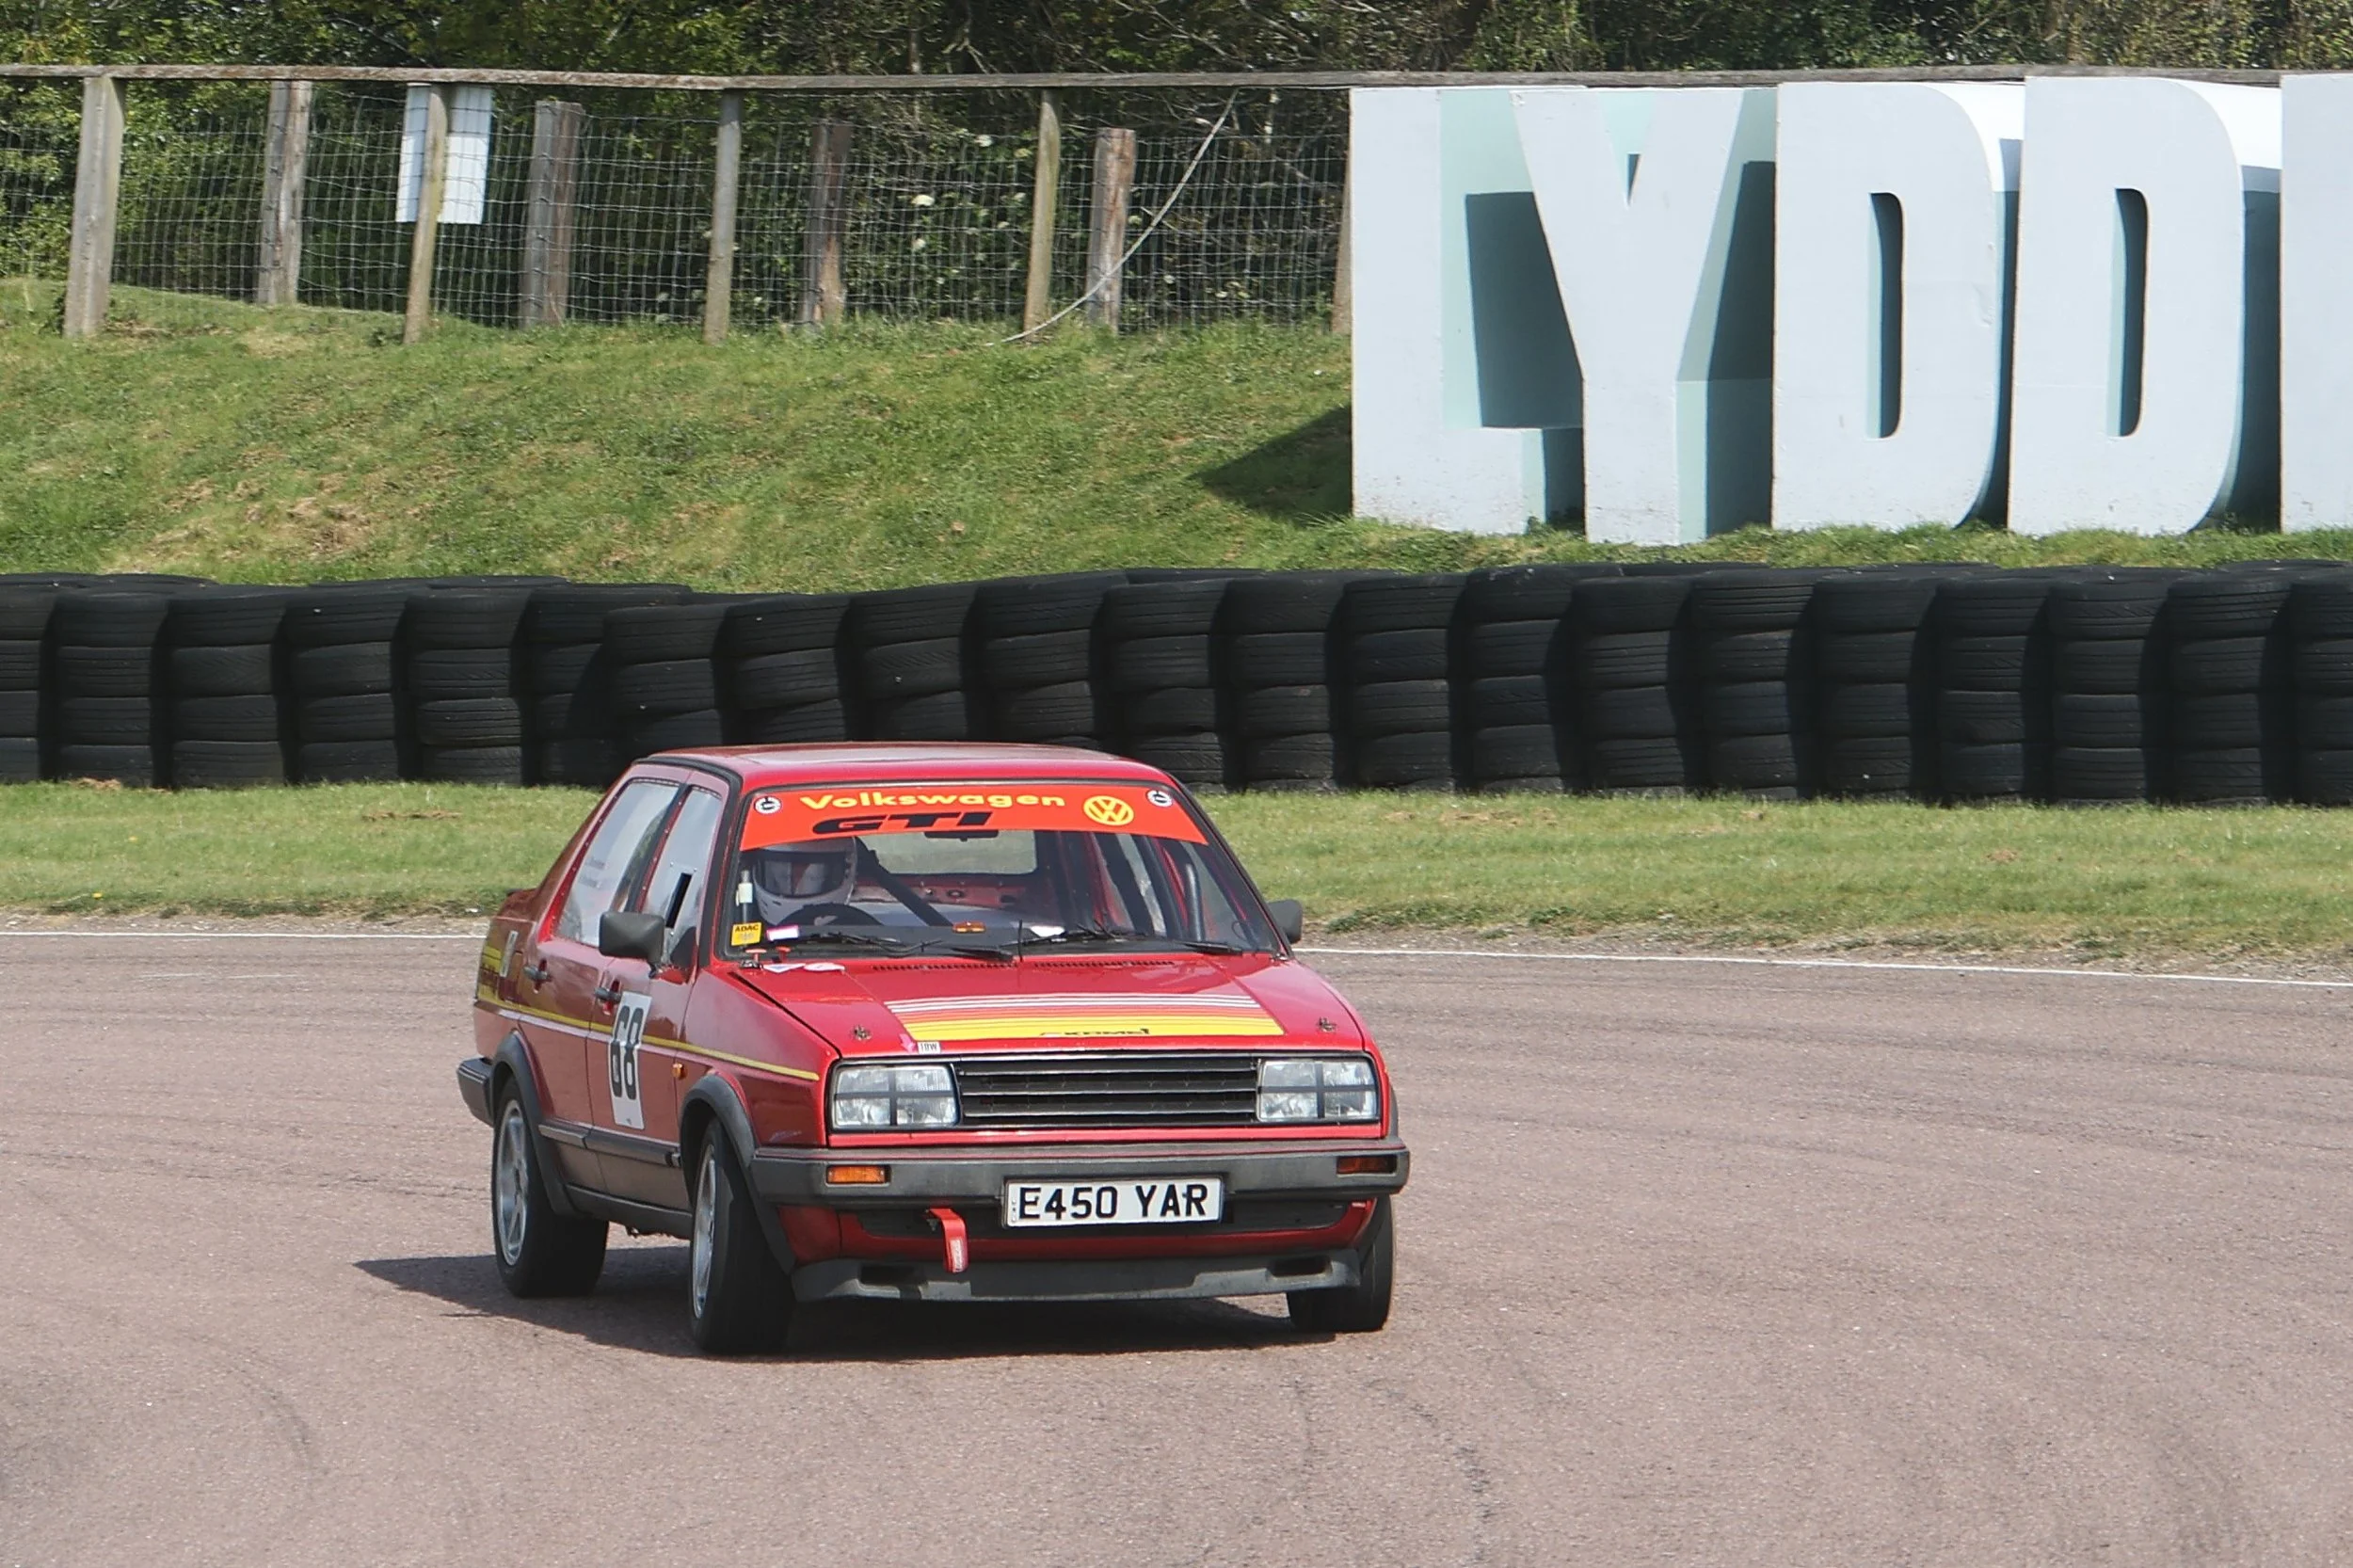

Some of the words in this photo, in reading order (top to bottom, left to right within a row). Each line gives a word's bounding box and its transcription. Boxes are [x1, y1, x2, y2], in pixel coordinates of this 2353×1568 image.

[800, 792, 1065, 810] Volkswagen
[1082, 795, 1135, 826] VW
[811, 811, 993, 835] GTI
[734, 923, 760, 933] ADAC
[610, 1004, 645, 1101] 68
[1018, 1185, 1118, 1221] E450
[1135, 1183, 1209, 1218] YAR
